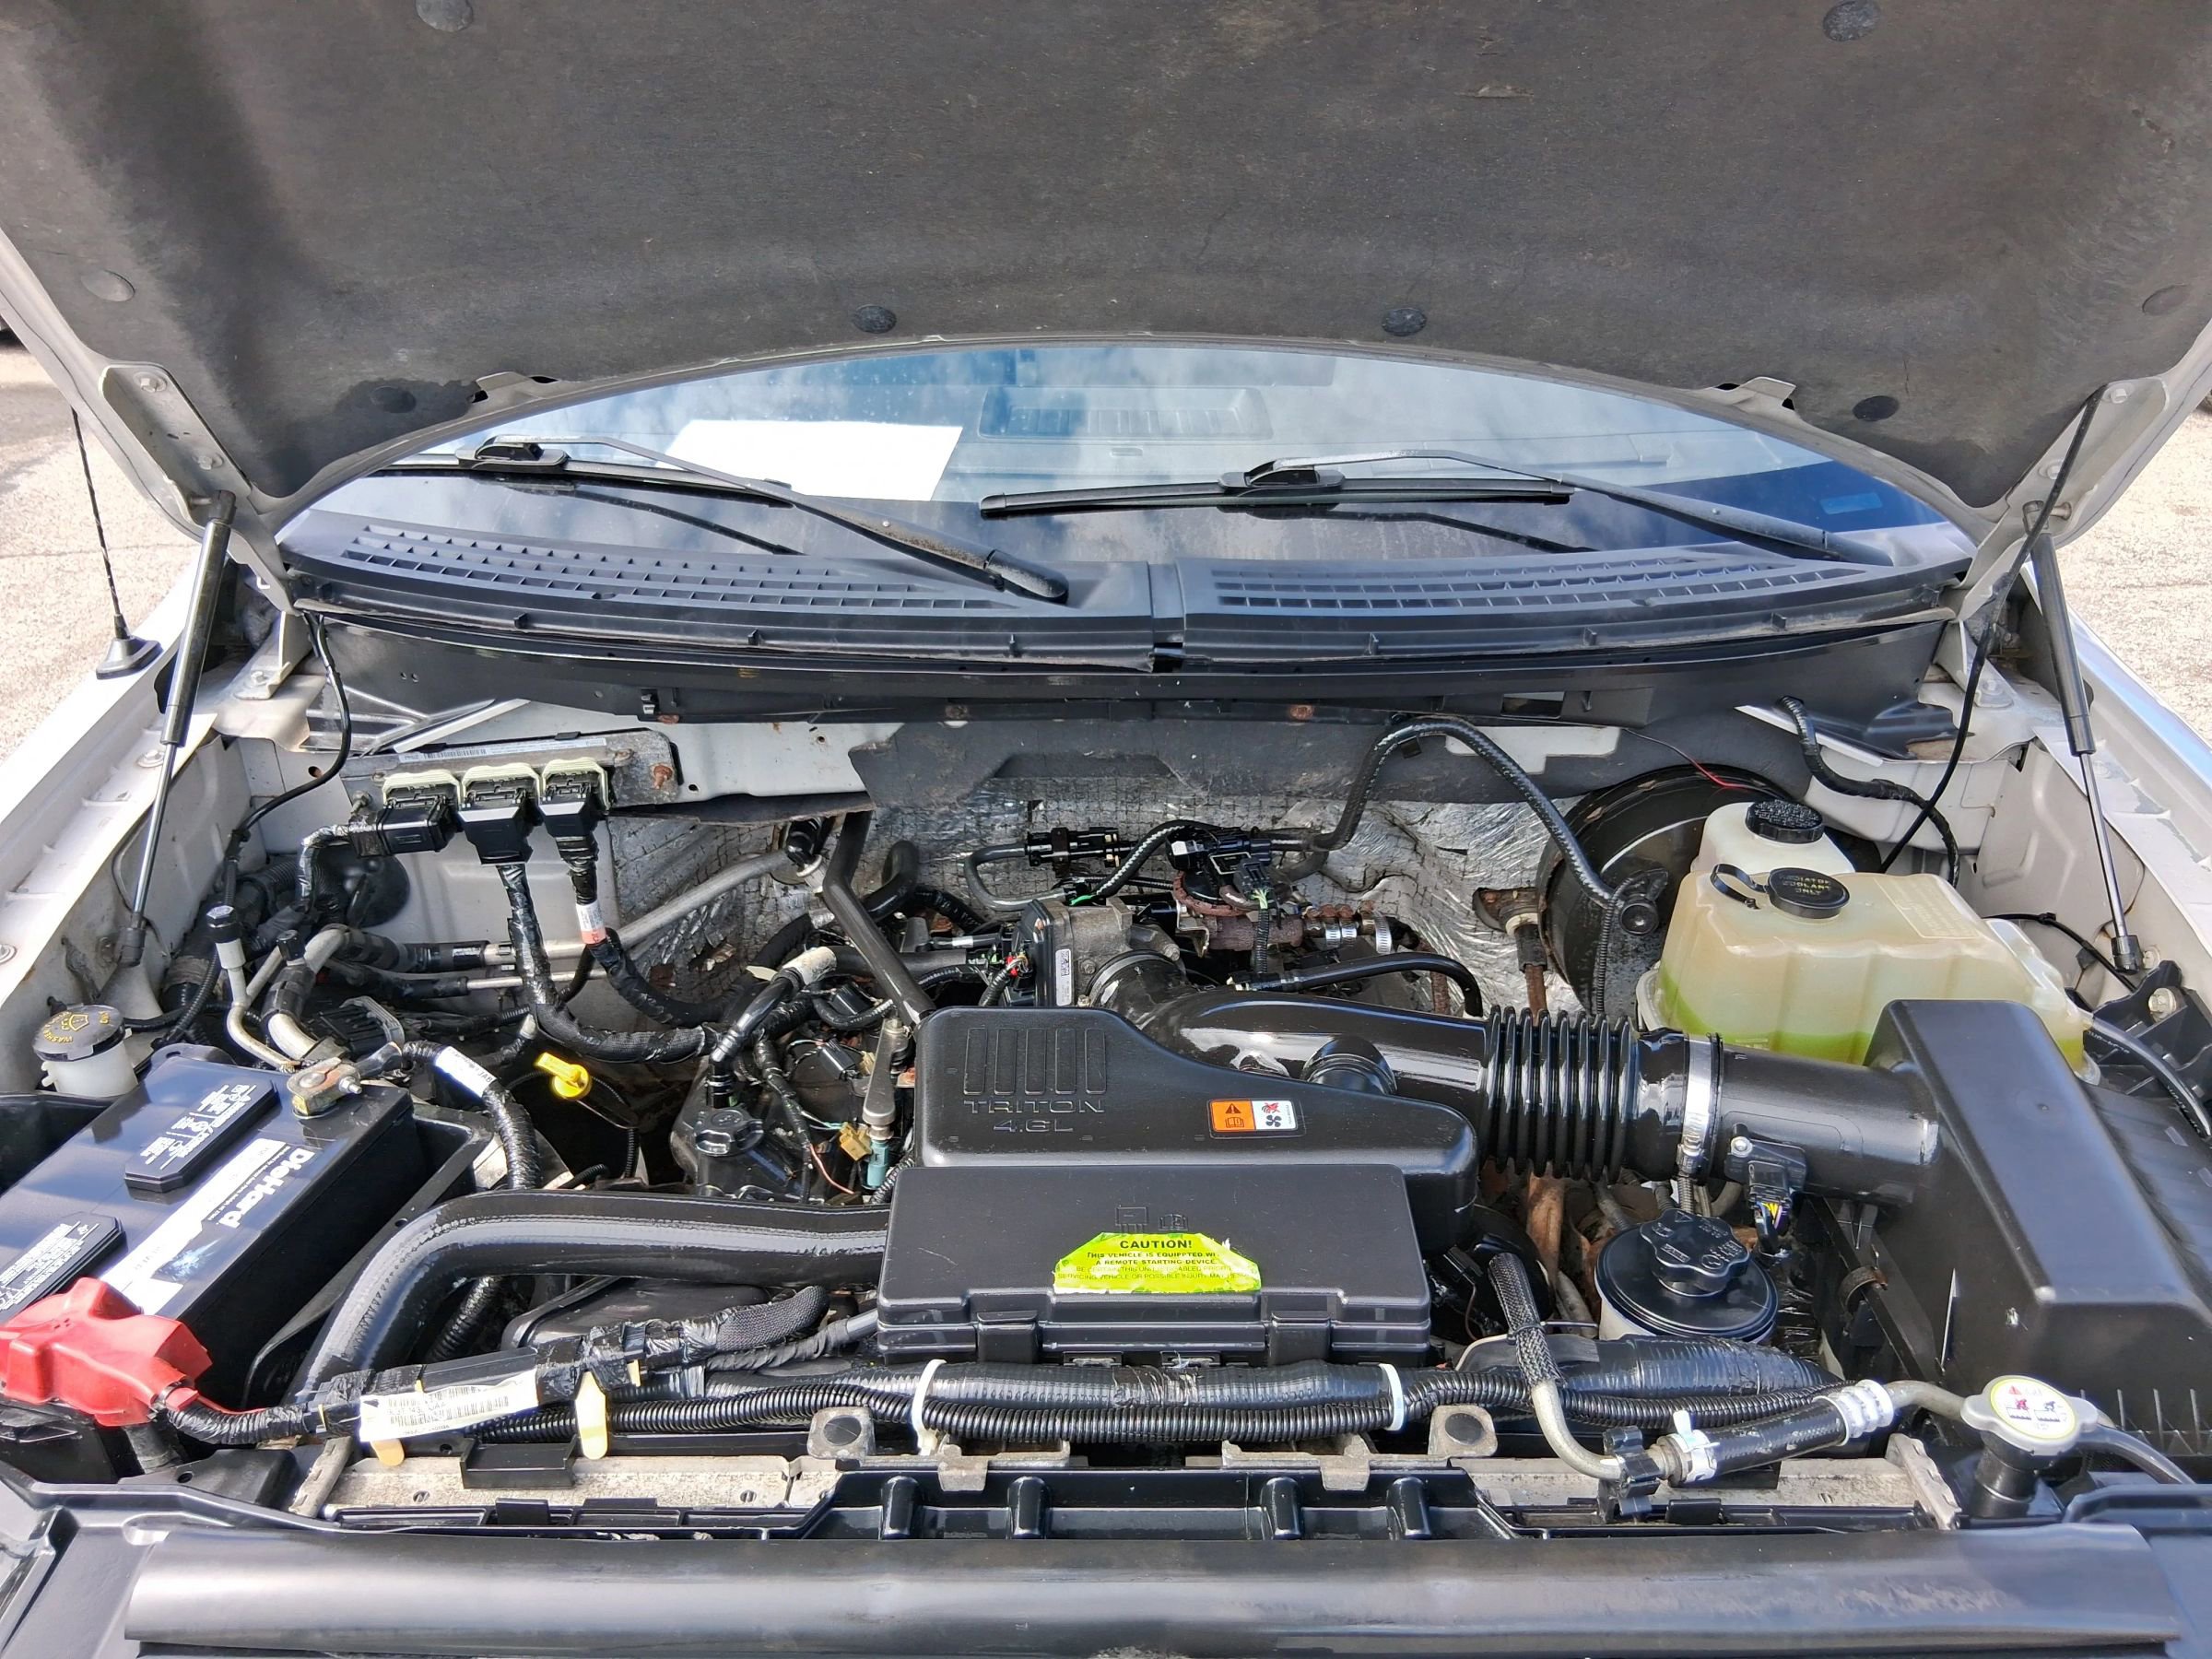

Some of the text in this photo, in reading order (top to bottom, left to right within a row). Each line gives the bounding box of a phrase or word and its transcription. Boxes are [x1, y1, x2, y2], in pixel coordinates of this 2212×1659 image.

[963, 1099, 1105, 1114] TRITON
[994, 1118, 1074, 1133] 4.6L
[218, 1147, 316, 1230] DieHard
[1120, 1240, 1192, 1249] CAUTION!
